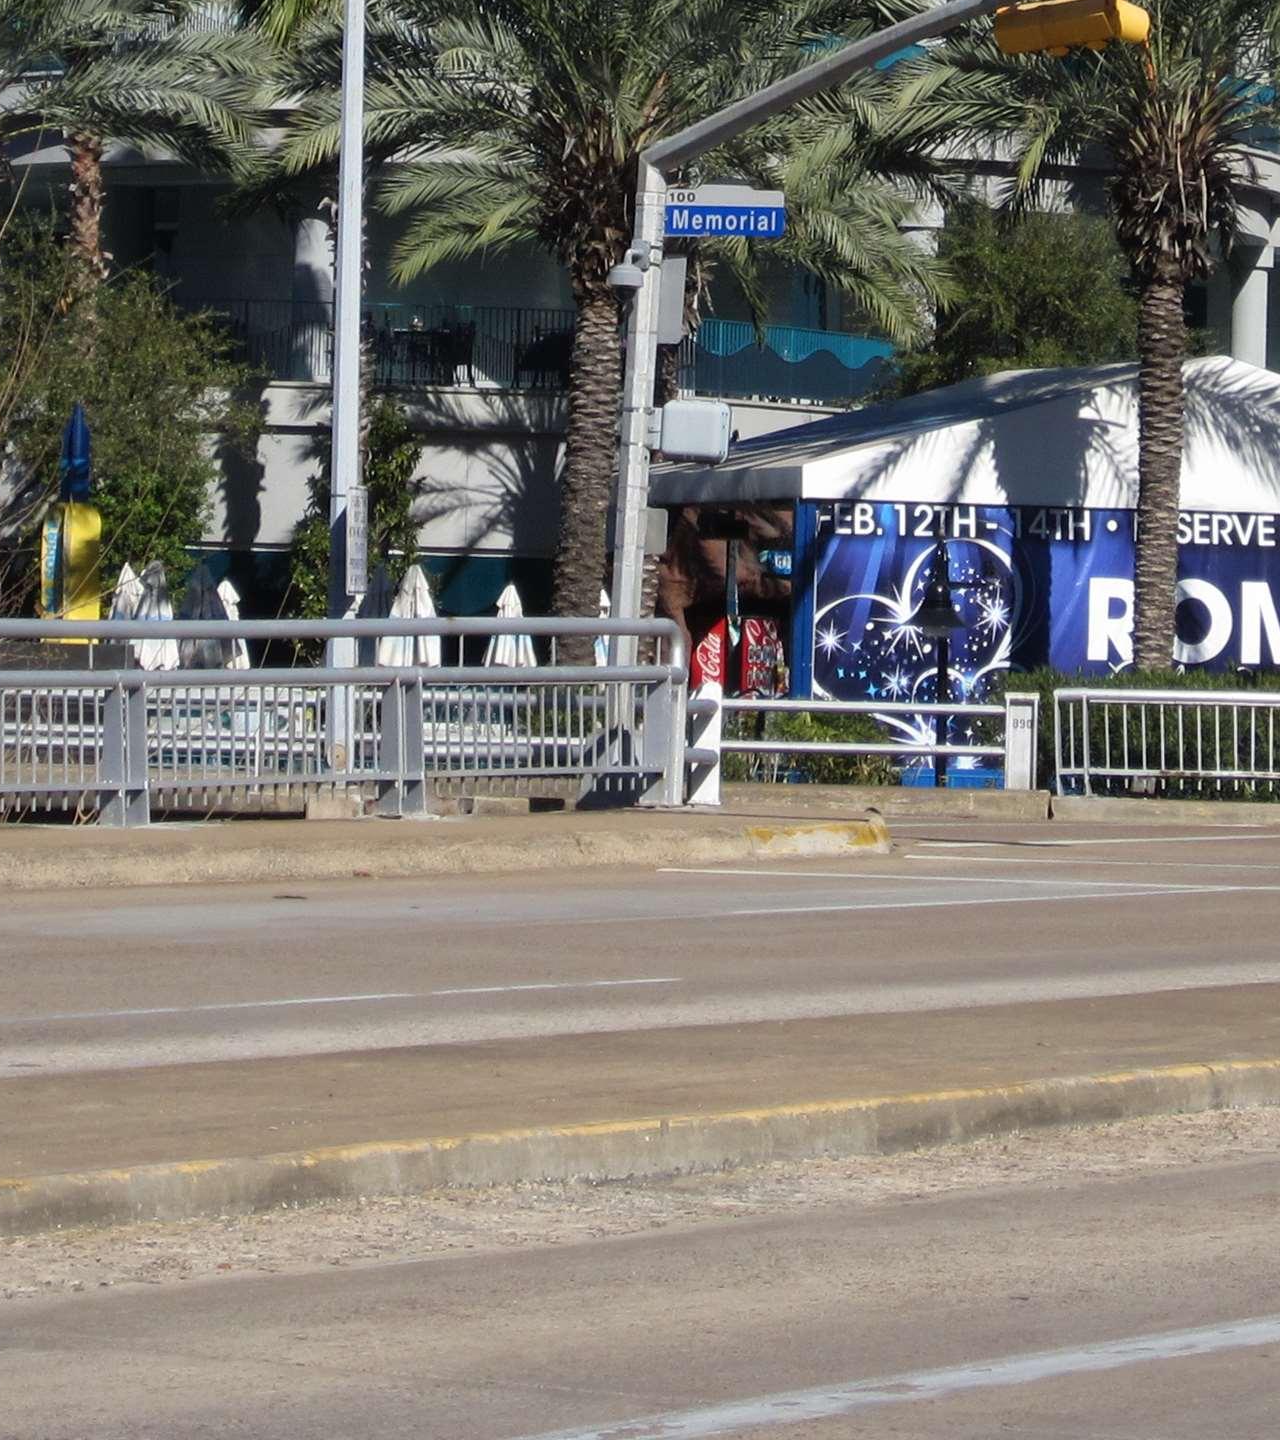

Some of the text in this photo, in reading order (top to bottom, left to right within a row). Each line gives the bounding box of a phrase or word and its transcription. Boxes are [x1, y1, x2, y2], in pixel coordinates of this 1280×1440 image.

[670, 192, 696, 203] 100
[672, 210, 776, 232] Memorial
[895, 504, 977, 538] 12TH
[1134, 511, 1276, 547] SERVE
